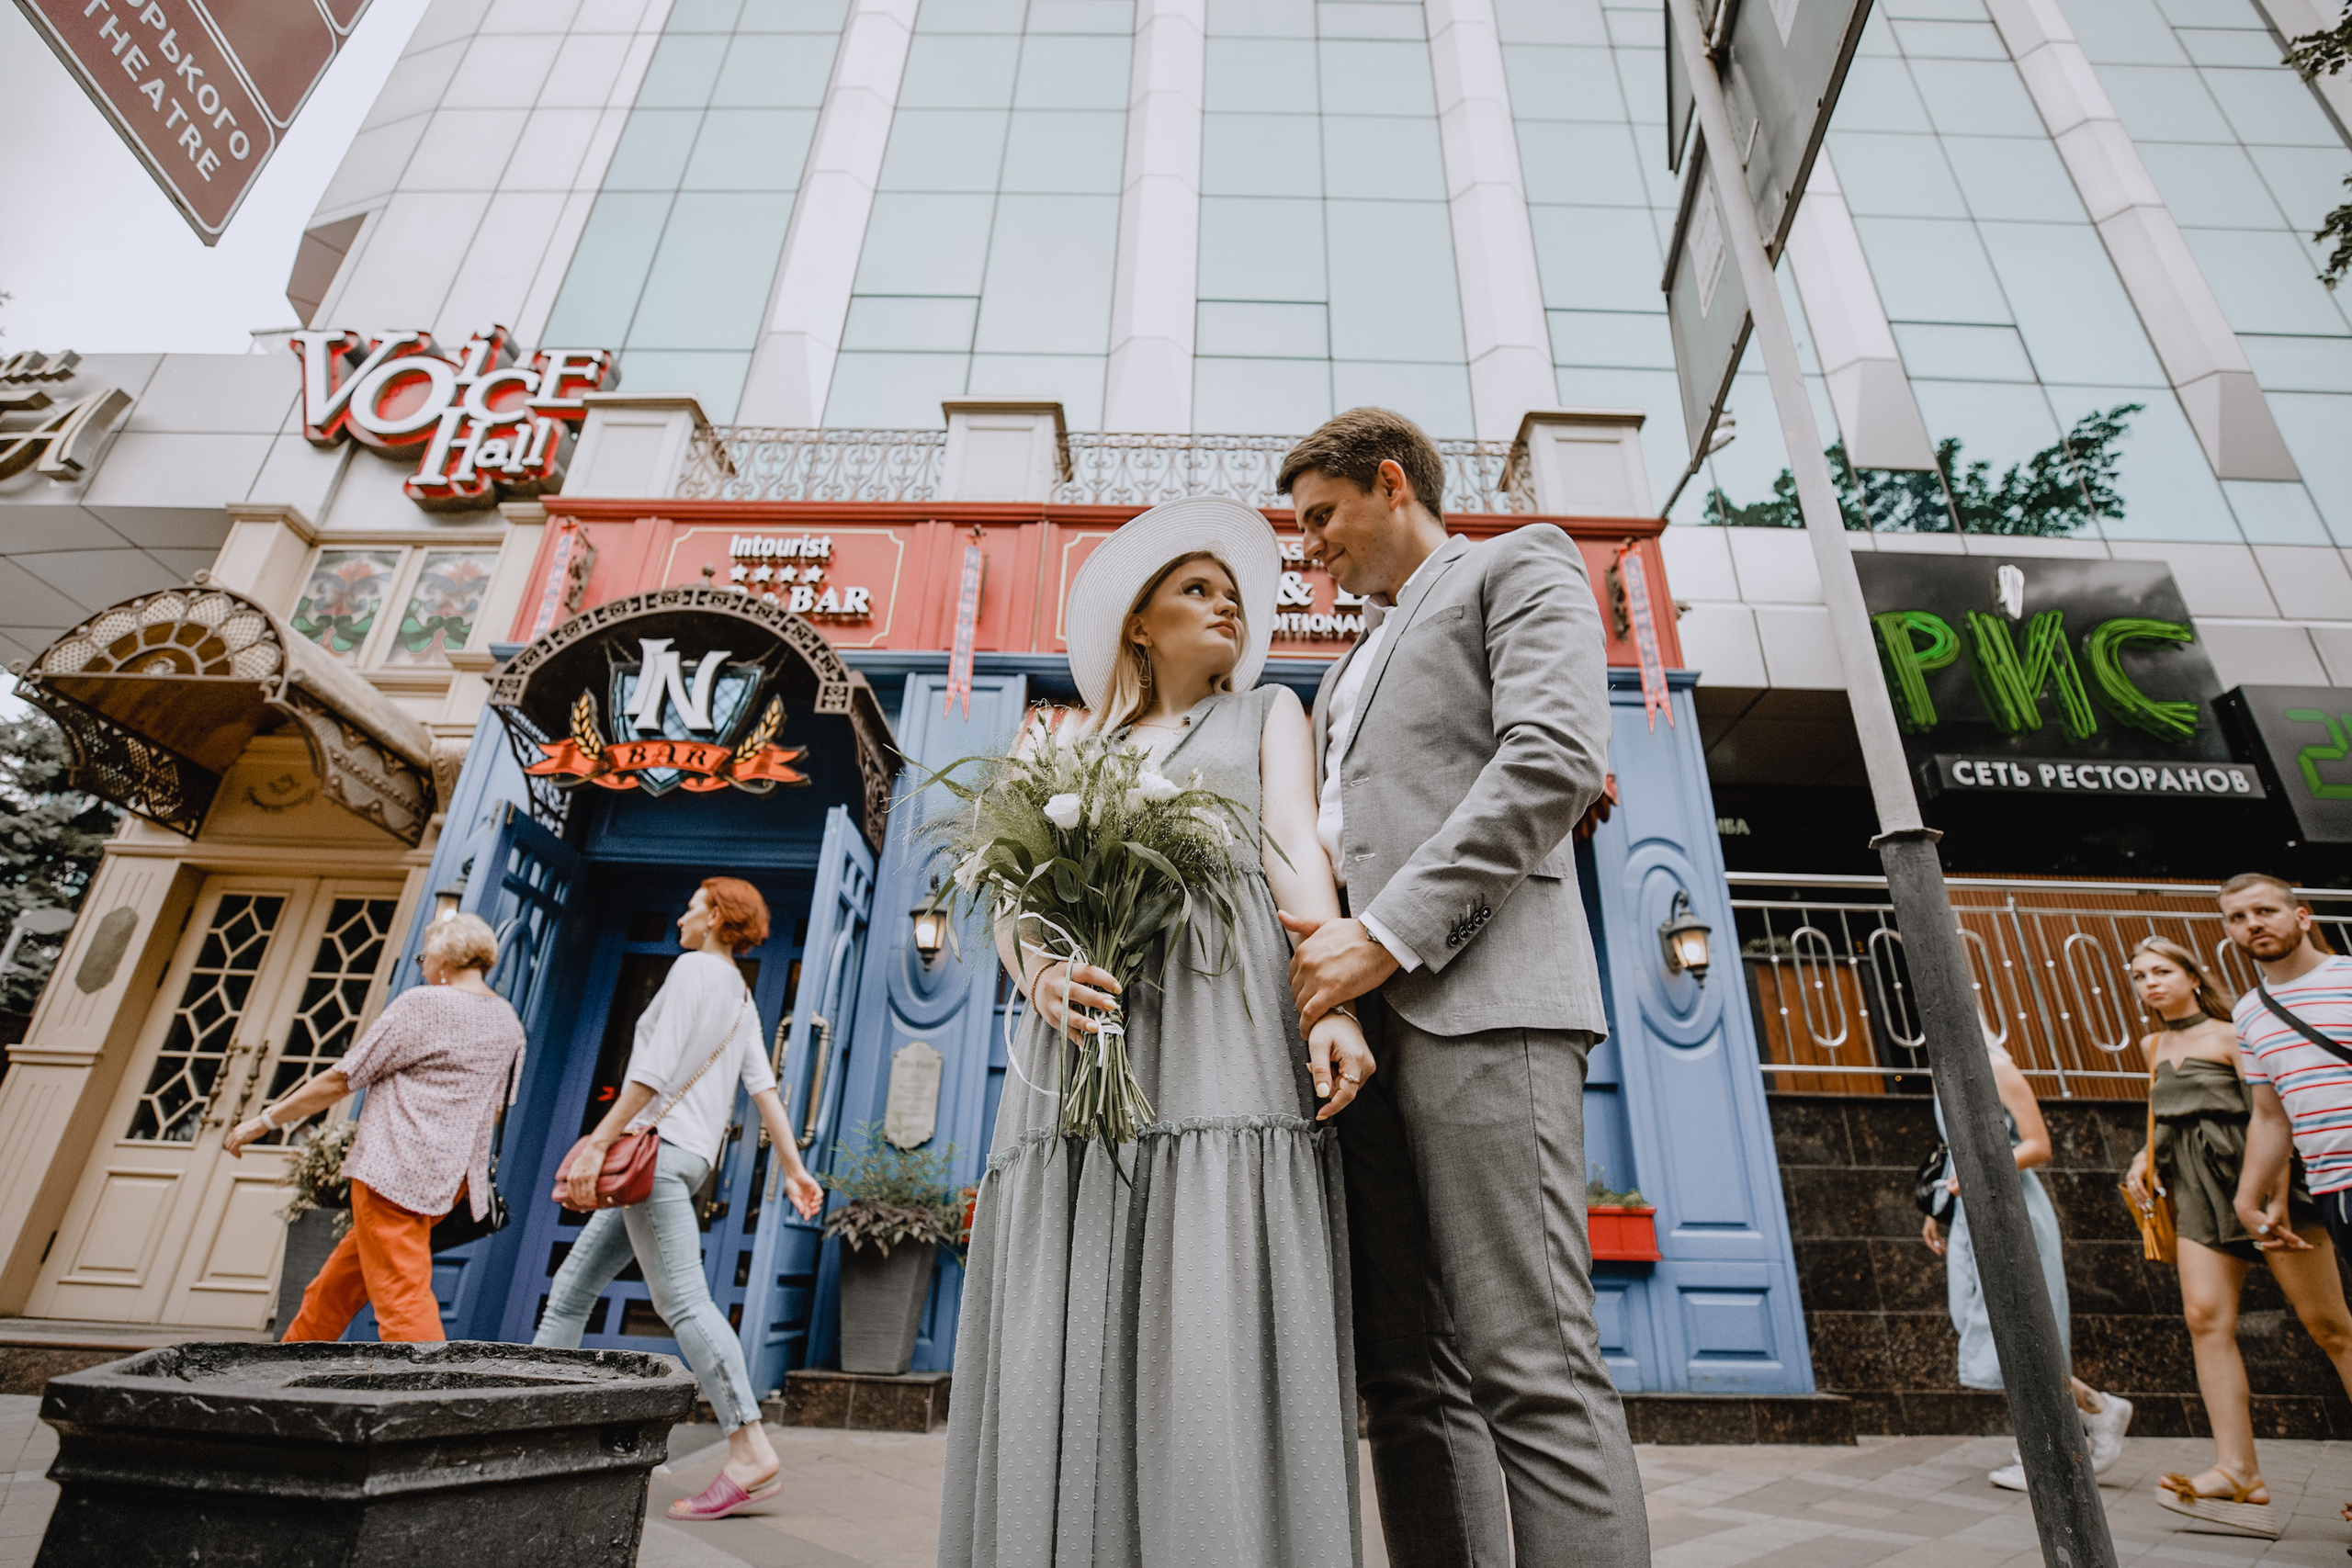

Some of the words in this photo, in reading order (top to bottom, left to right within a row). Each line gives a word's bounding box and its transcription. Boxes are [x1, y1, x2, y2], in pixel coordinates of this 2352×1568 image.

[84, 0, 221, 182] THEATRE
[409, 407, 553, 485] Hall
[729, 534, 832, 558] Intourist
[788, 585, 870, 614] BAR
[1871, 608, 2199, 739] РИС
[628, 742, 707, 766] BAR
[1951, 760, 2031, 787] СЕТЬ
[2037, 762, 2251, 794] РЕСТОРАНОВ
